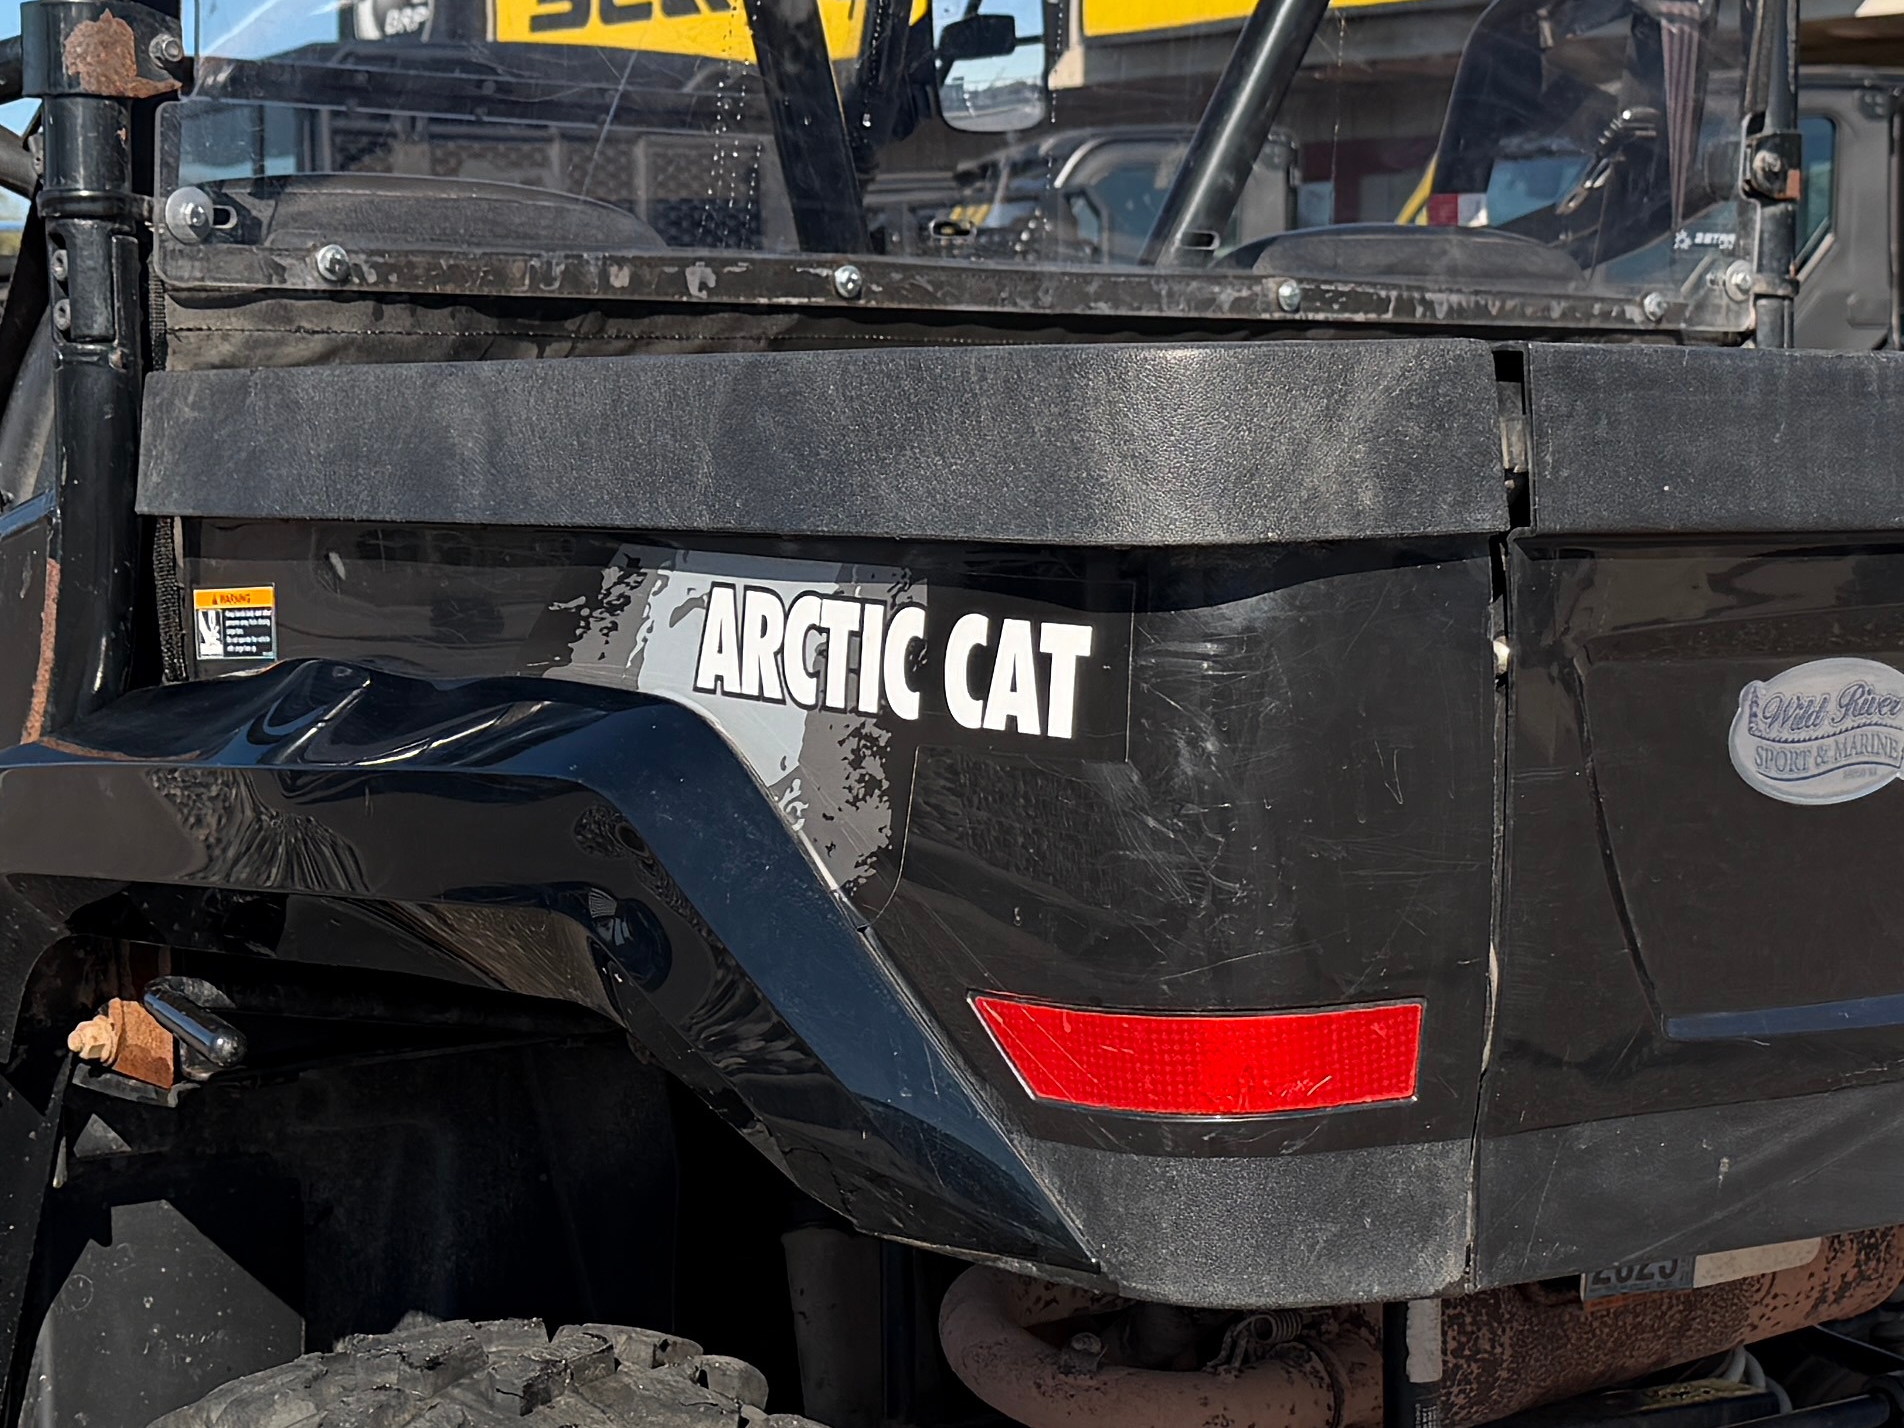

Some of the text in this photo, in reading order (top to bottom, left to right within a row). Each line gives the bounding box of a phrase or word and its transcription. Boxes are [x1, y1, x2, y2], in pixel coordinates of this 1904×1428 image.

[694, 583, 1094, 740] ARCTIC CAT
[1761, 693, 1830, 733] Wild
[1754, 743, 1812, 773] SPORT
[1834, 731, 1899, 762] MARINE
